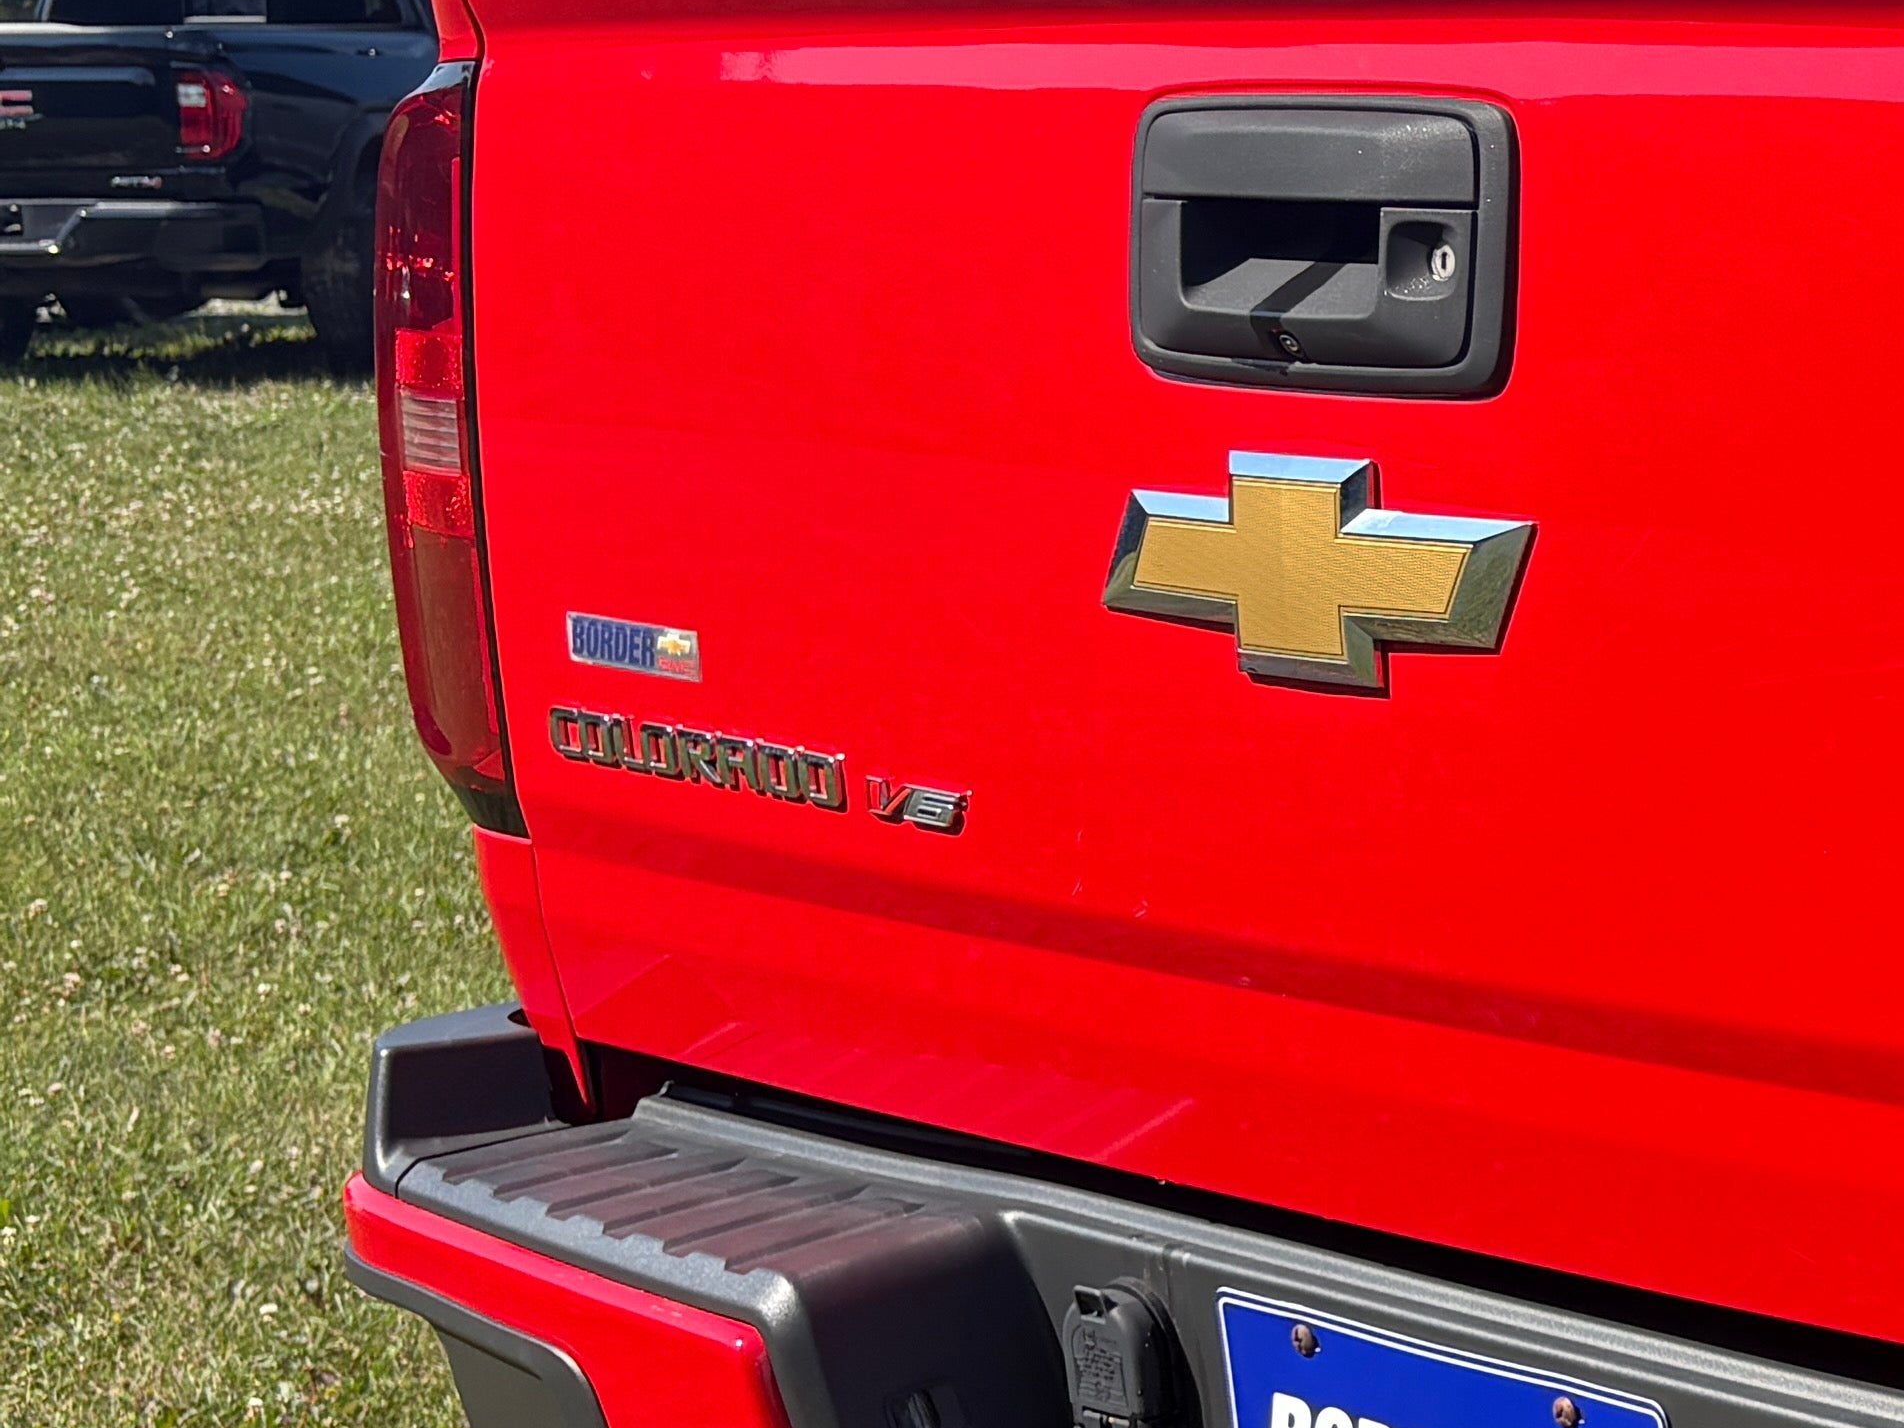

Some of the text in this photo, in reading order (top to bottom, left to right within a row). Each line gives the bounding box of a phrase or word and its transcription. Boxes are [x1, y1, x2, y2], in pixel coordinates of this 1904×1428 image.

[572, 615, 655, 668] BORDER
[549, 706, 971, 831] COLORADO V6
